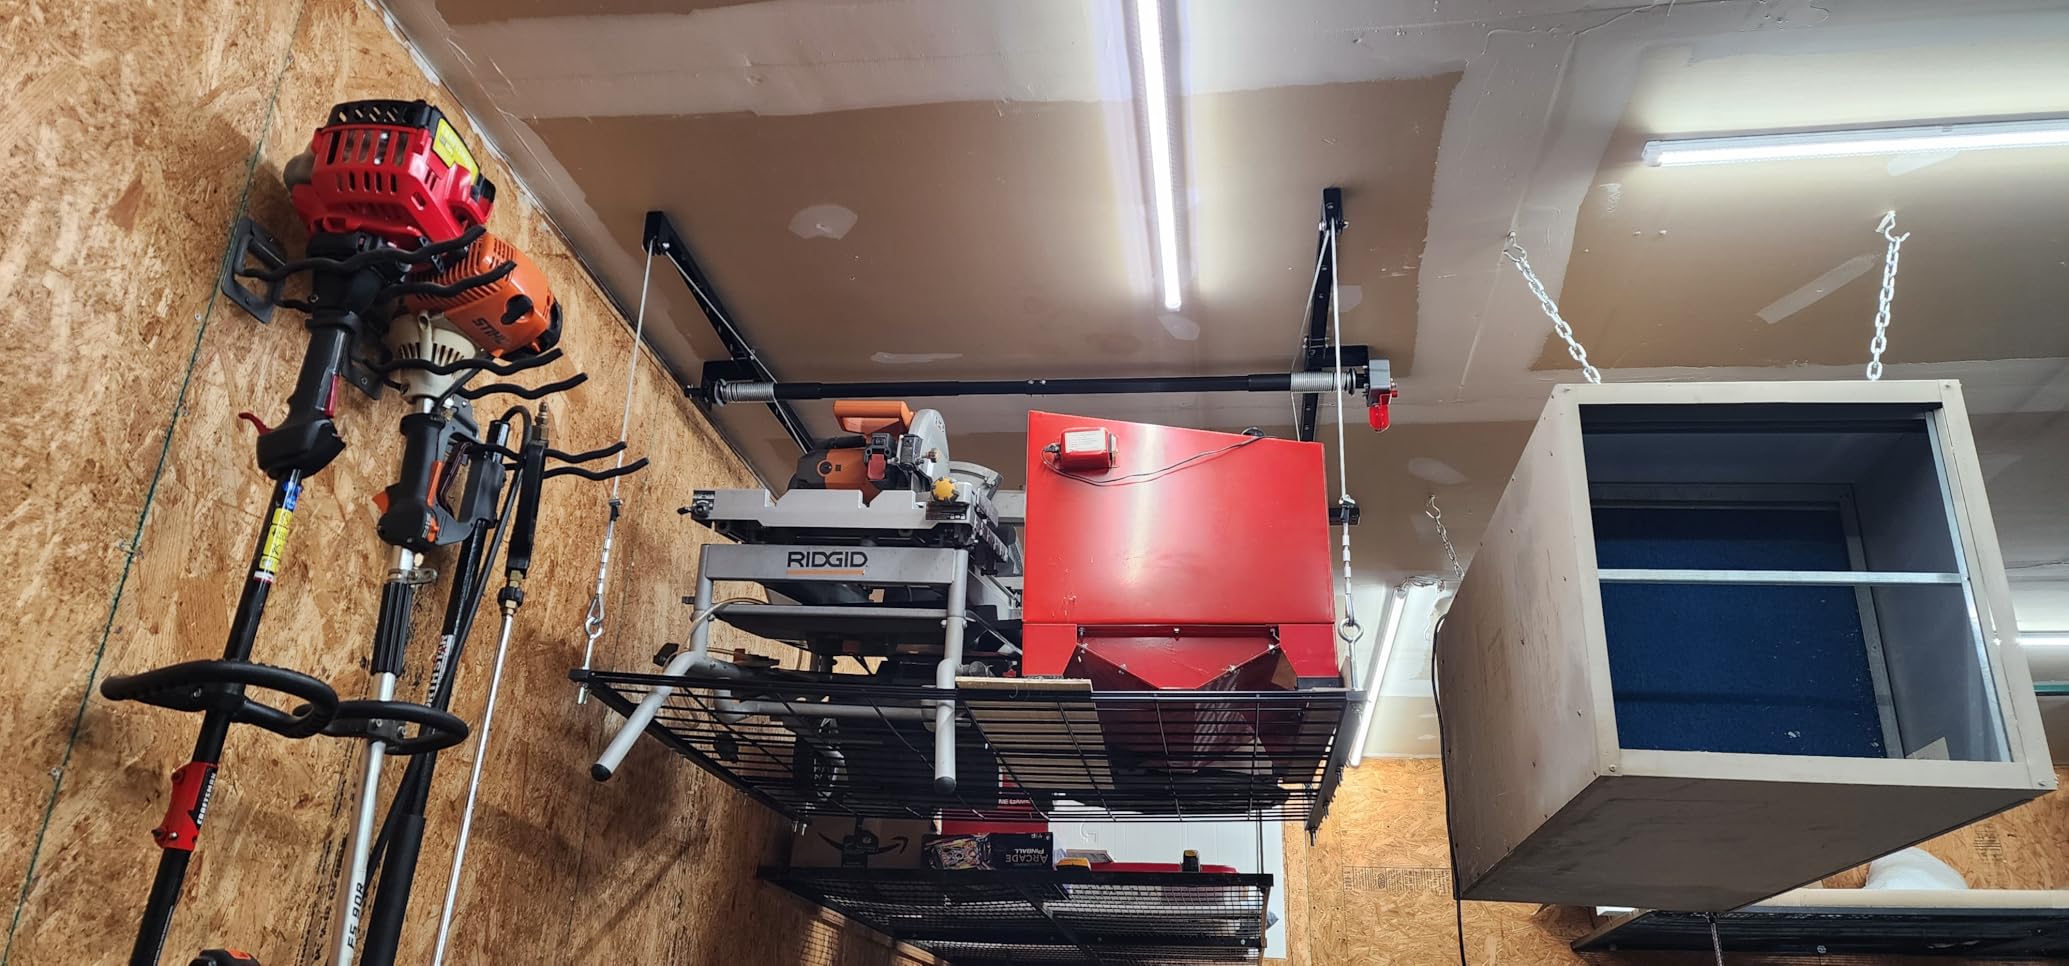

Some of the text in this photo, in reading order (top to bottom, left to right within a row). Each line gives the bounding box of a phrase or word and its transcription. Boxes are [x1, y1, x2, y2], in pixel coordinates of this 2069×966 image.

[472, 317, 507, 345] STIHL
[786, 551, 868, 568] RIDGID
[196, 772, 217, 825] CRAFTSMAN
[1005, 853, 1049, 864] ARCADE
[347, 882, 364, 950] FS 90R
